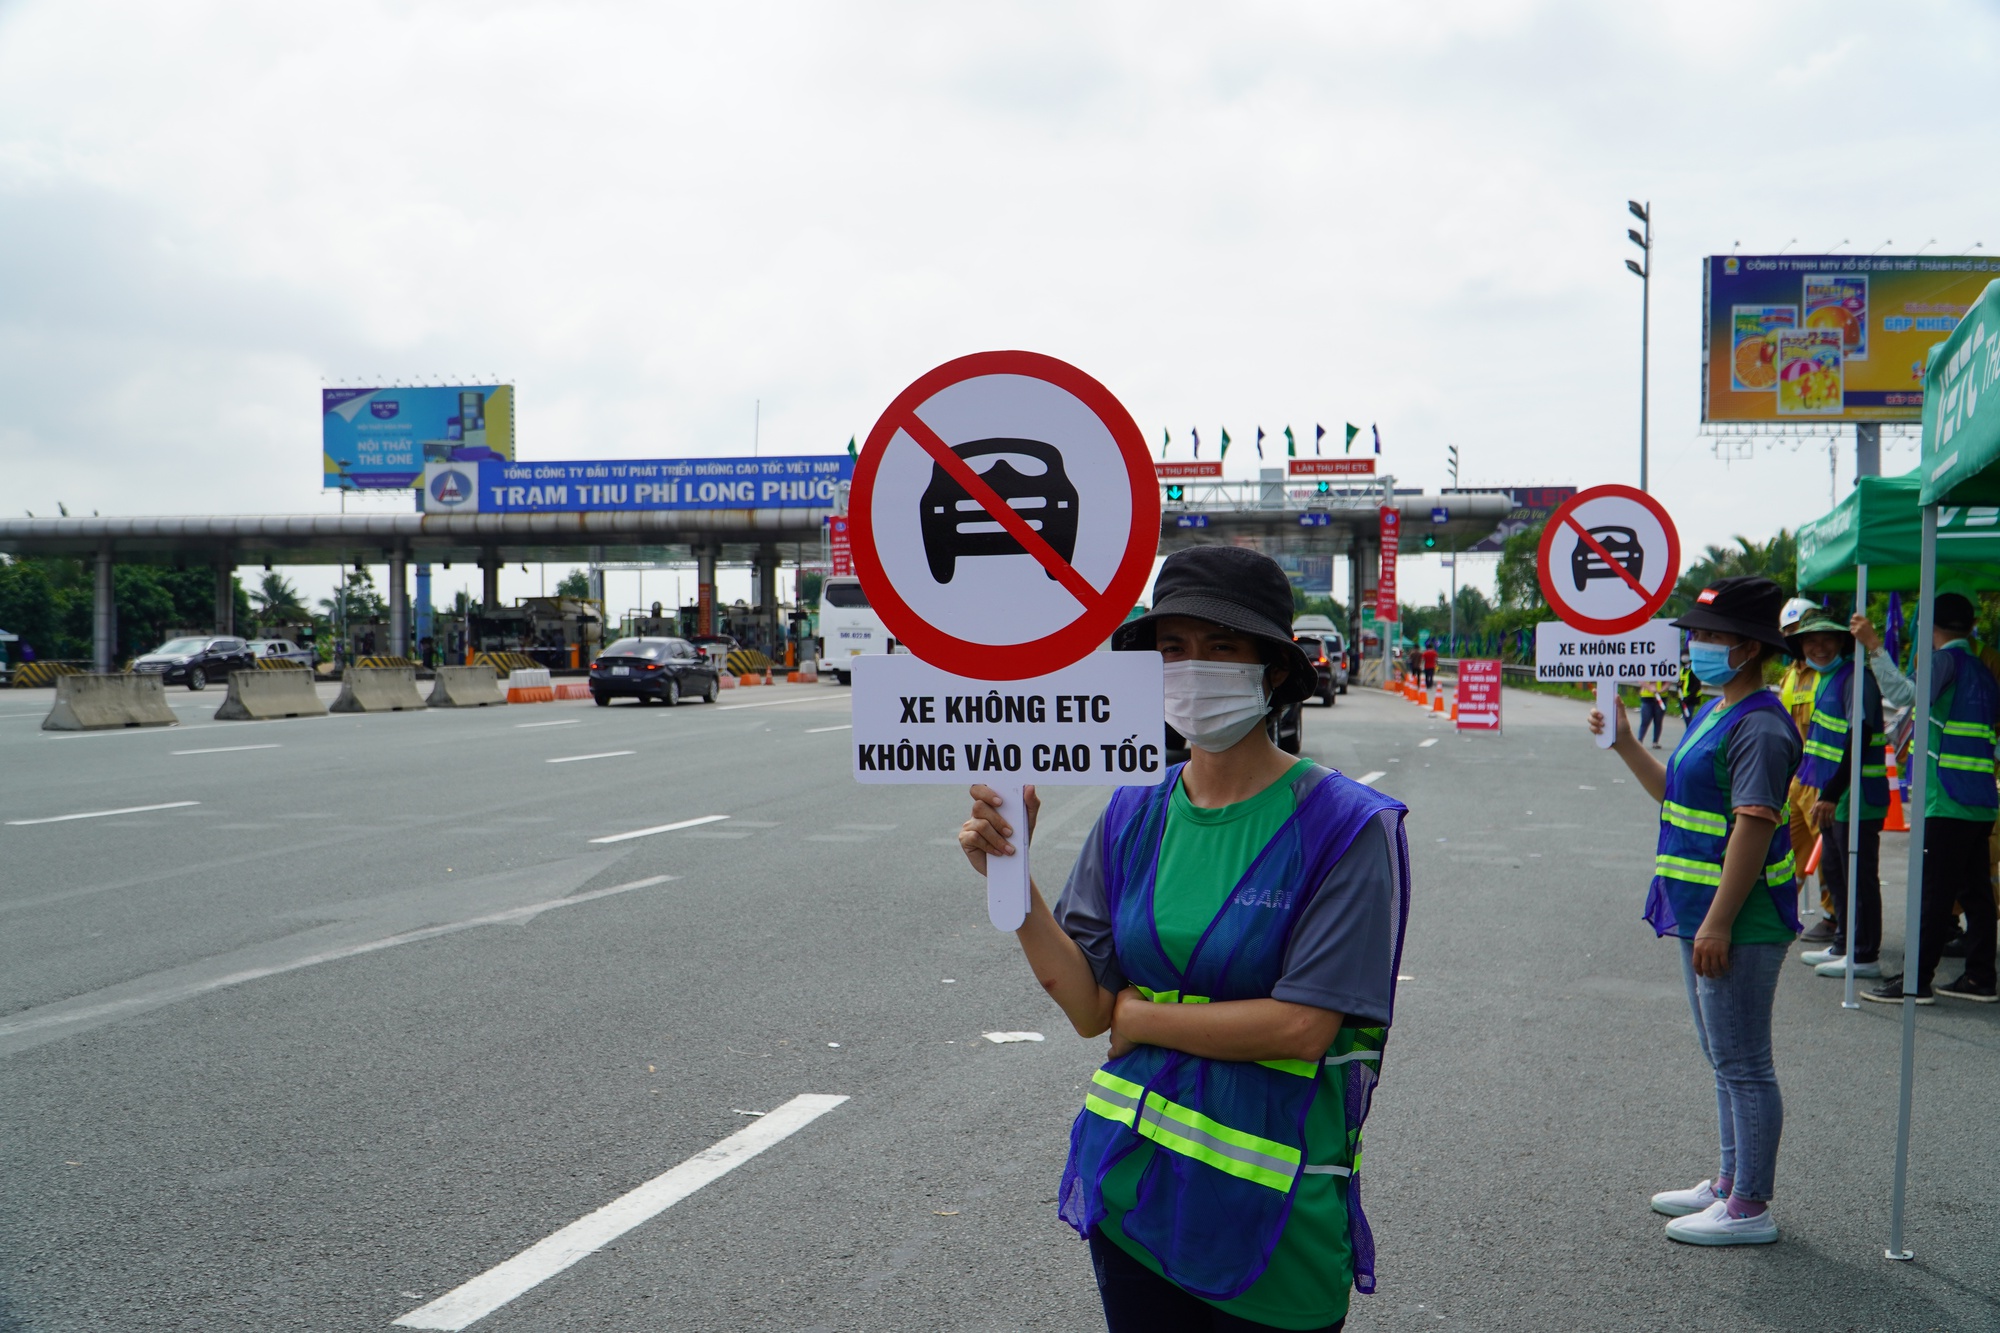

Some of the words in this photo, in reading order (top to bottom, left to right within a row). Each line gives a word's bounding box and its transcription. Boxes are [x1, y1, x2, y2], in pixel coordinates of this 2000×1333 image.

[1746, 259, 1777, 271] CÔNG
[1779, 262, 1790, 271] TY
[1791, 261, 1818, 270] TNHH
[1820, 261, 1841, 270] MTV
[358, 439, 379, 453] NỘI
[359, 454, 383, 465] THE
[387, 454, 413, 465] ONE
[503, 464, 532, 479] TỔNG
[535, 465, 566, 479] CÔNG
[569, 467, 584, 478] TY
[630, 465, 658, 477] PHÁT
[736, 464, 759, 475] CAO
[762, 460, 784, 475] TỐC
[787, 461, 811, 476] VIỆT
[814, 462, 840, 473] NAM
[1165, 467, 1182, 475] THU
[1183, 465, 1198, 475] PHÍ
[1199, 466, 1216, 474] ETC
[1316, 464, 1333, 472] THU
[1335, 463, 1350, 471] PHÍ
[1351, 463, 1369, 471] ETC
[490, 486, 568, 510] TRẠM
[575, 484, 628, 505] THU
[635, 478, 678, 504] PHÍ
[685, 481, 755, 503] LONG
[1559, 643, 1575, 655] XE
[1580, 640, 1626, 655] KHÔNG
[1630, 641, 1656, 655] ETC
[1467, 663, 1493, 672] VETC
[1539, 662, 1584, 677] KHÔNG
[1588, 661, 1614, 677] VÀO
[1619, 664, 1646, 677] CAO
[1650, 659, 1677, 677] TỐC
[899, 697, 935, 724] XE
[946, 690, 1046, 724] KHÔNG
[1056, 695, 1111, 724] ETC
[858, 739, 955, 771] KHÔNG
[965, 739, 1021, 772] VÀO
[1032, 744, 1091, 772] CAO
[1101, 735, 1159, 773] TỐC
